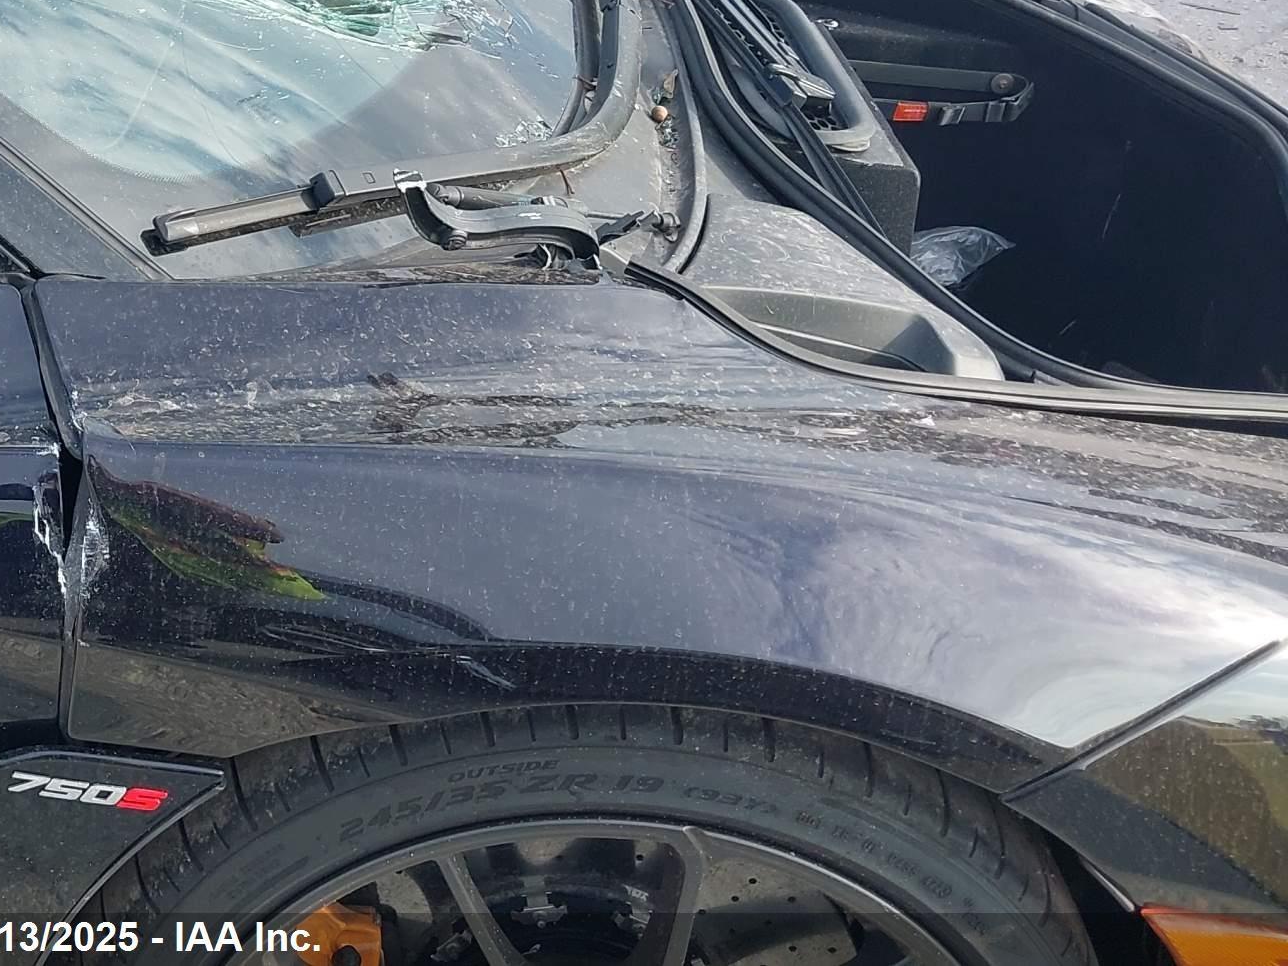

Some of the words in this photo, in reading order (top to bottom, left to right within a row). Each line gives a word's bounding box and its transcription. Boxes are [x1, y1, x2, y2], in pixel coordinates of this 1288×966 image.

[7, 770, 169, 812] 750S
[447, 759, 561, 783] OUTSIDE
[339, 779, 511, 843] 245/35
[518, 773, 598, 795] ZR
[615, 774, 665, 794] 19
